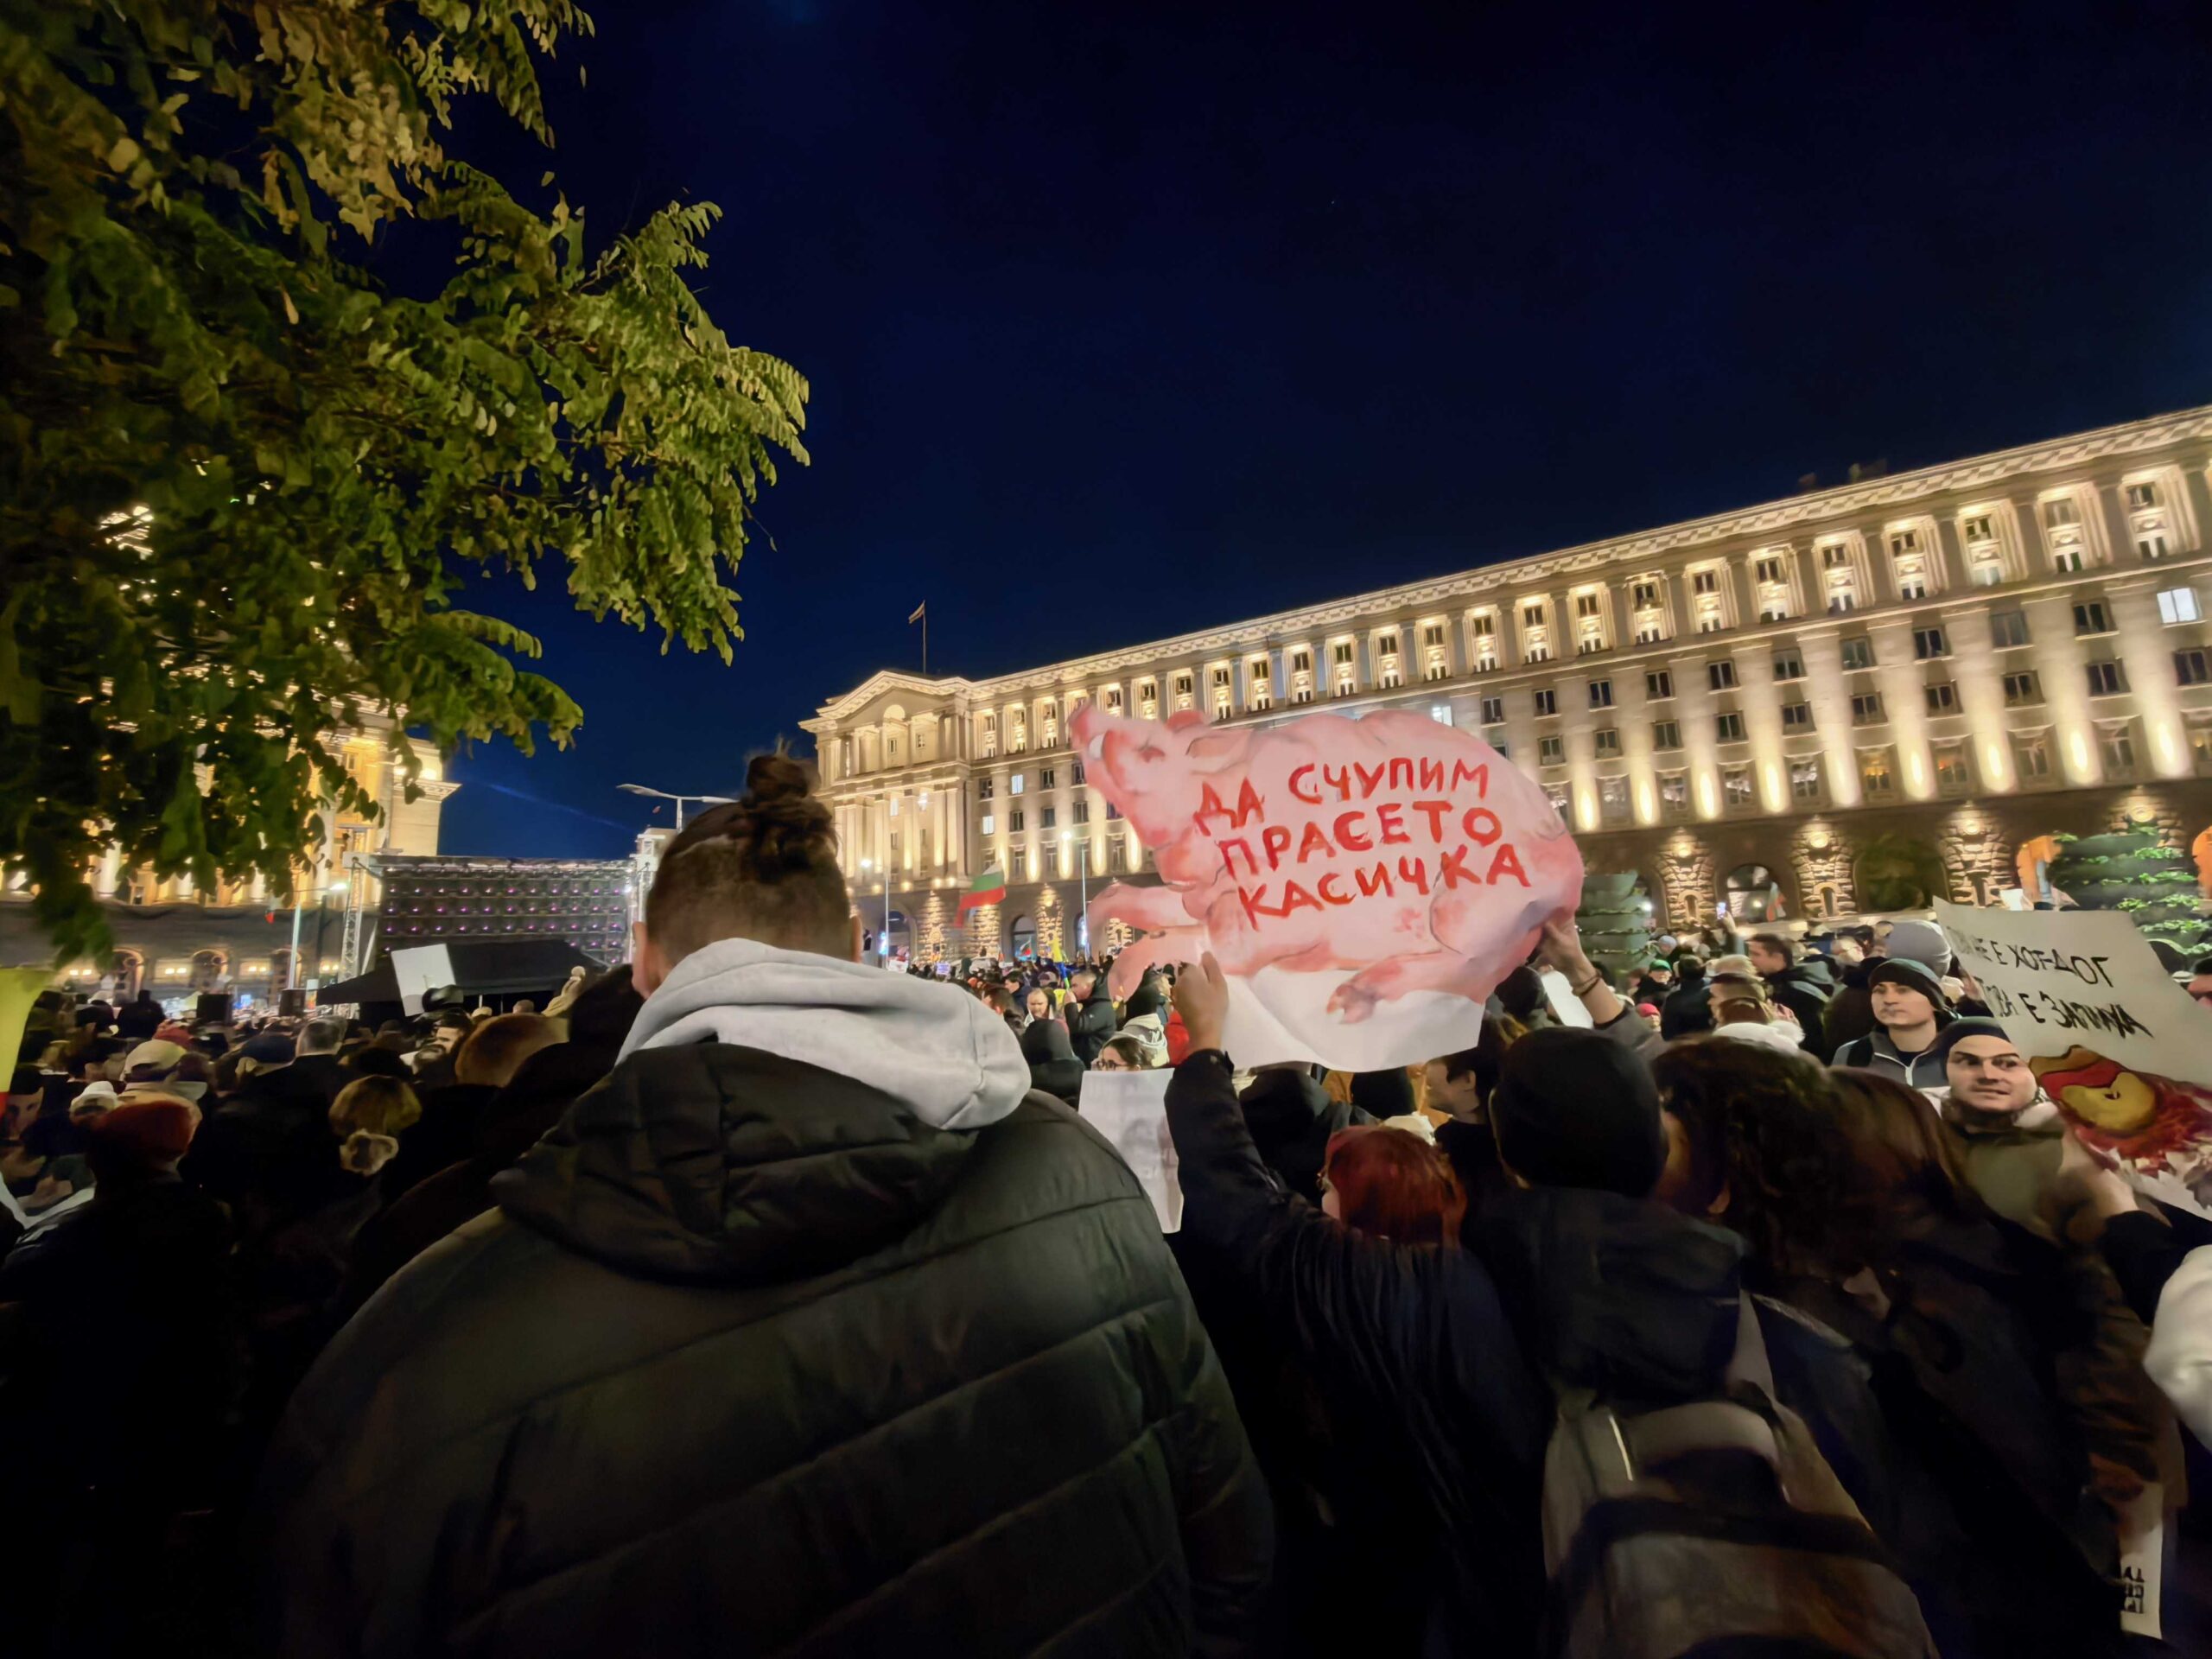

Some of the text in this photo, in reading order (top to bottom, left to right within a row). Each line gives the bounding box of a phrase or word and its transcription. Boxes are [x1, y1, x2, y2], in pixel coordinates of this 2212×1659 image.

[1193, 757, 1488, 836] ДА СЧУПИМ
[1218, 800, 1503, 878] ПРАСЕТО
[1238, 843, 1531, 931] КАСИЧКА
[2018, 992, 2046, 1024] Е
